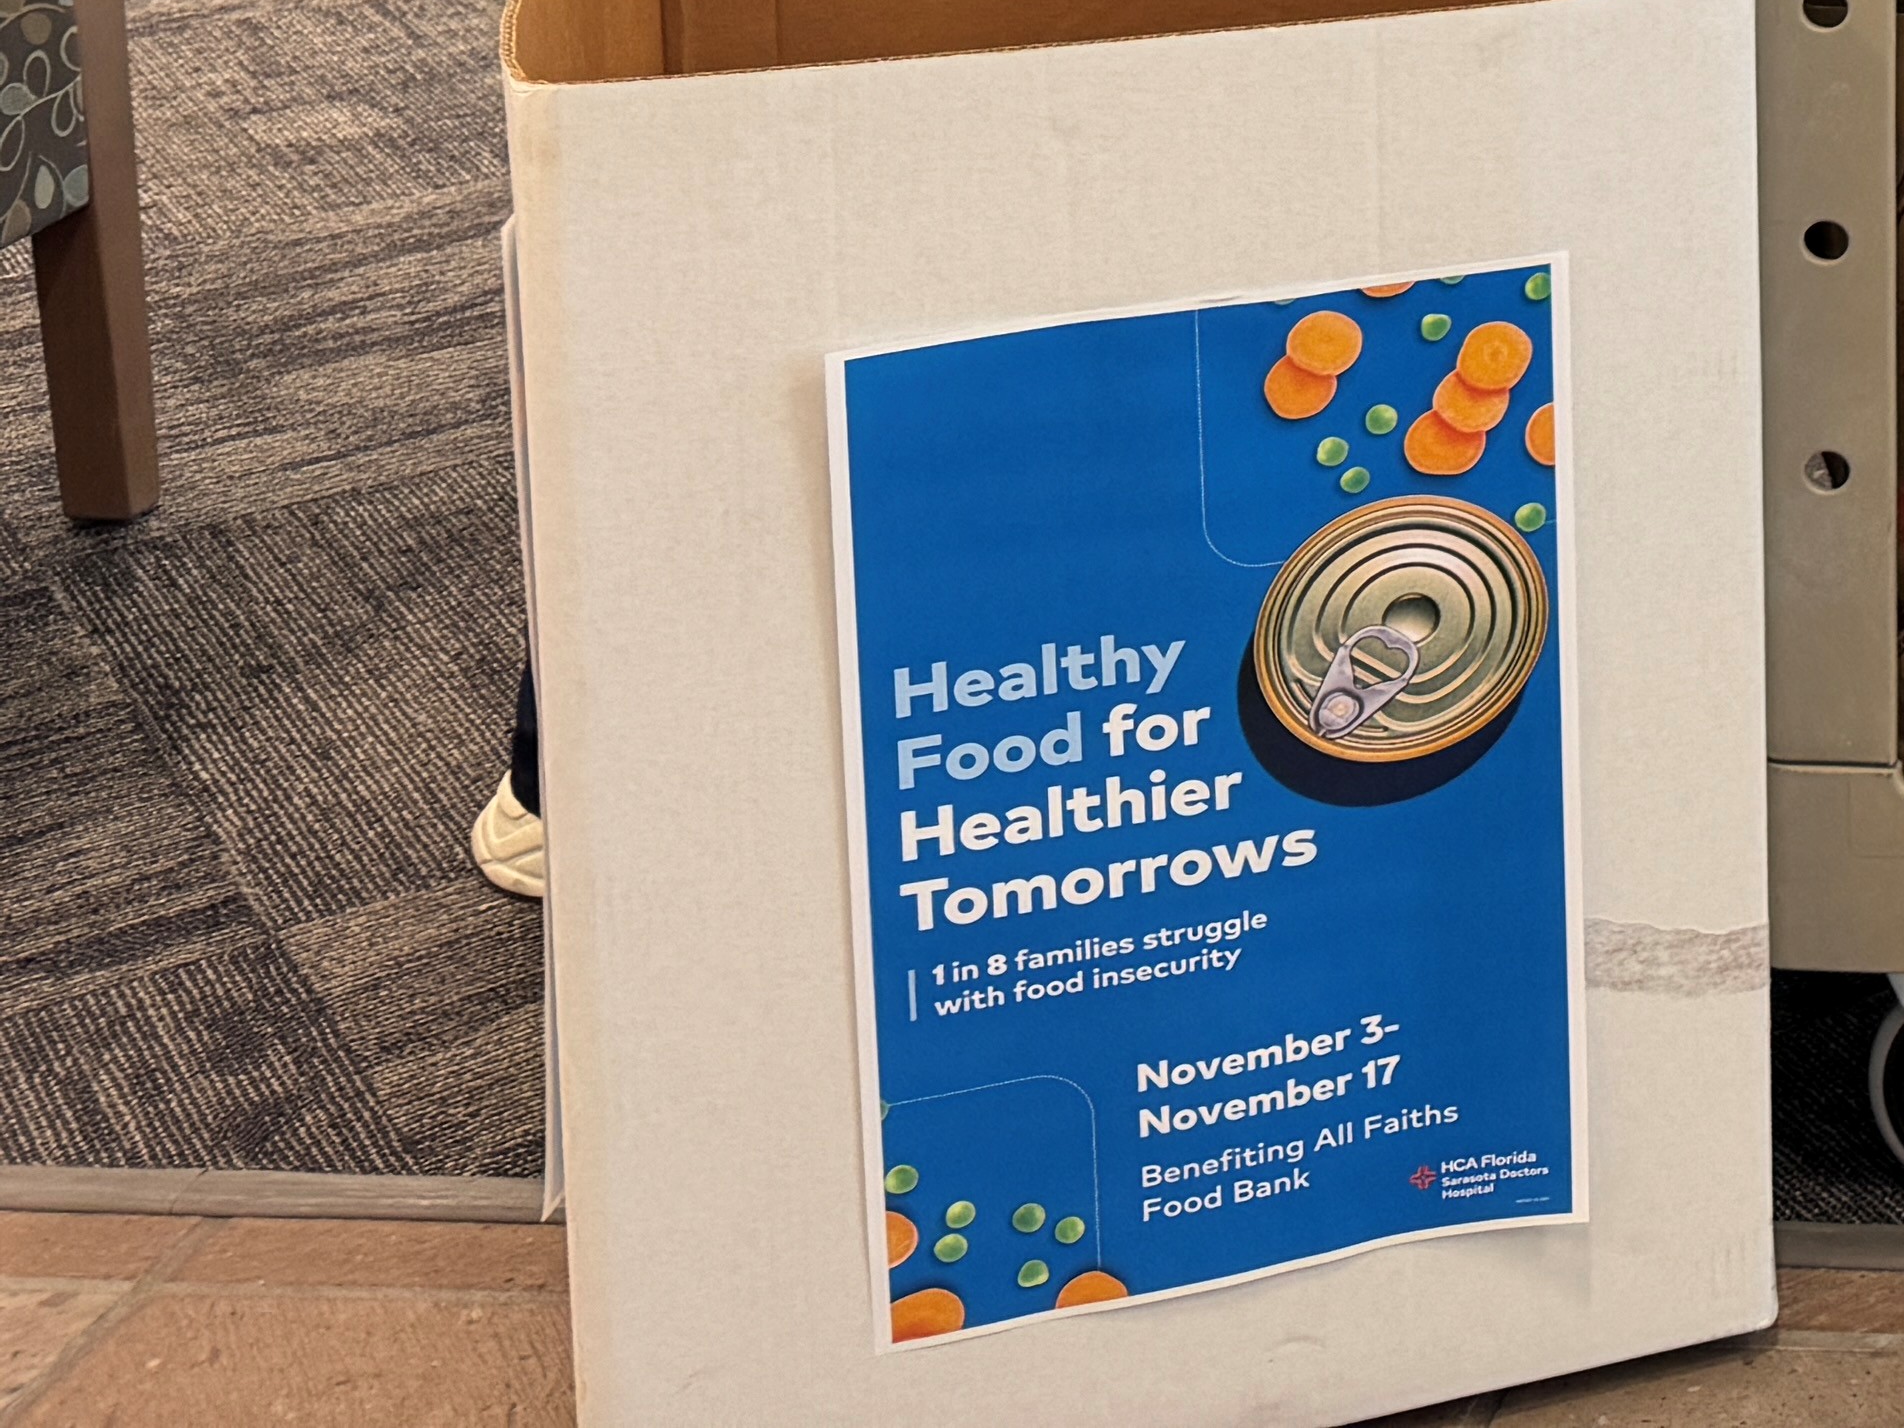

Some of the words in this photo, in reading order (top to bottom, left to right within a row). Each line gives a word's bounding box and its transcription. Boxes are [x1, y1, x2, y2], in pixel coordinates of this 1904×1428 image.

[894, 634, 1186, 719] Healthy
[898, 710, 1083, 790] Food
[1102, 702, 1211, 757] for
[901, 769, 1243, 862] Healthier
[900, 830, 1318, 932] Tomorrows
[931, 963, 945, 986] 1
[952, 962, 980, 983] in
[987, 953, 1008, 976] 8
[1014, 934, 1135, 972] families
[1142, 910, 1268, 950] struggle
[934, 986, 1005, 1017] with
[1012, 971, 1084, 1003] food
[1093, 948, 1242, 989] insecurity
[1137, 1028, 1352, 1093] November
[1360, 1014, 1400, 1045] 3-
[1139, 1072, 1353, 1138] November
[1361, 1054, 1401, 1089] 17
[1141, 1139, 1304, 1188] Benefiting
[1313, 1121, 1353, 1152] All
[1364, 1104, 1459, 1140] Faiths
[1441, 1156, 1479, 1174] HCA
[1481, 1149, 1537, 1169] Florida
[1441, 1172, 1497, 1188] Sarasota
[1499, 1166, 1550, 1180] Doctors
[1143, 1179, 1223, 1222] Food
[1233, 1167, 1310, 1204] Bank
[1441, 1183, 1494, 1200] Hospital
